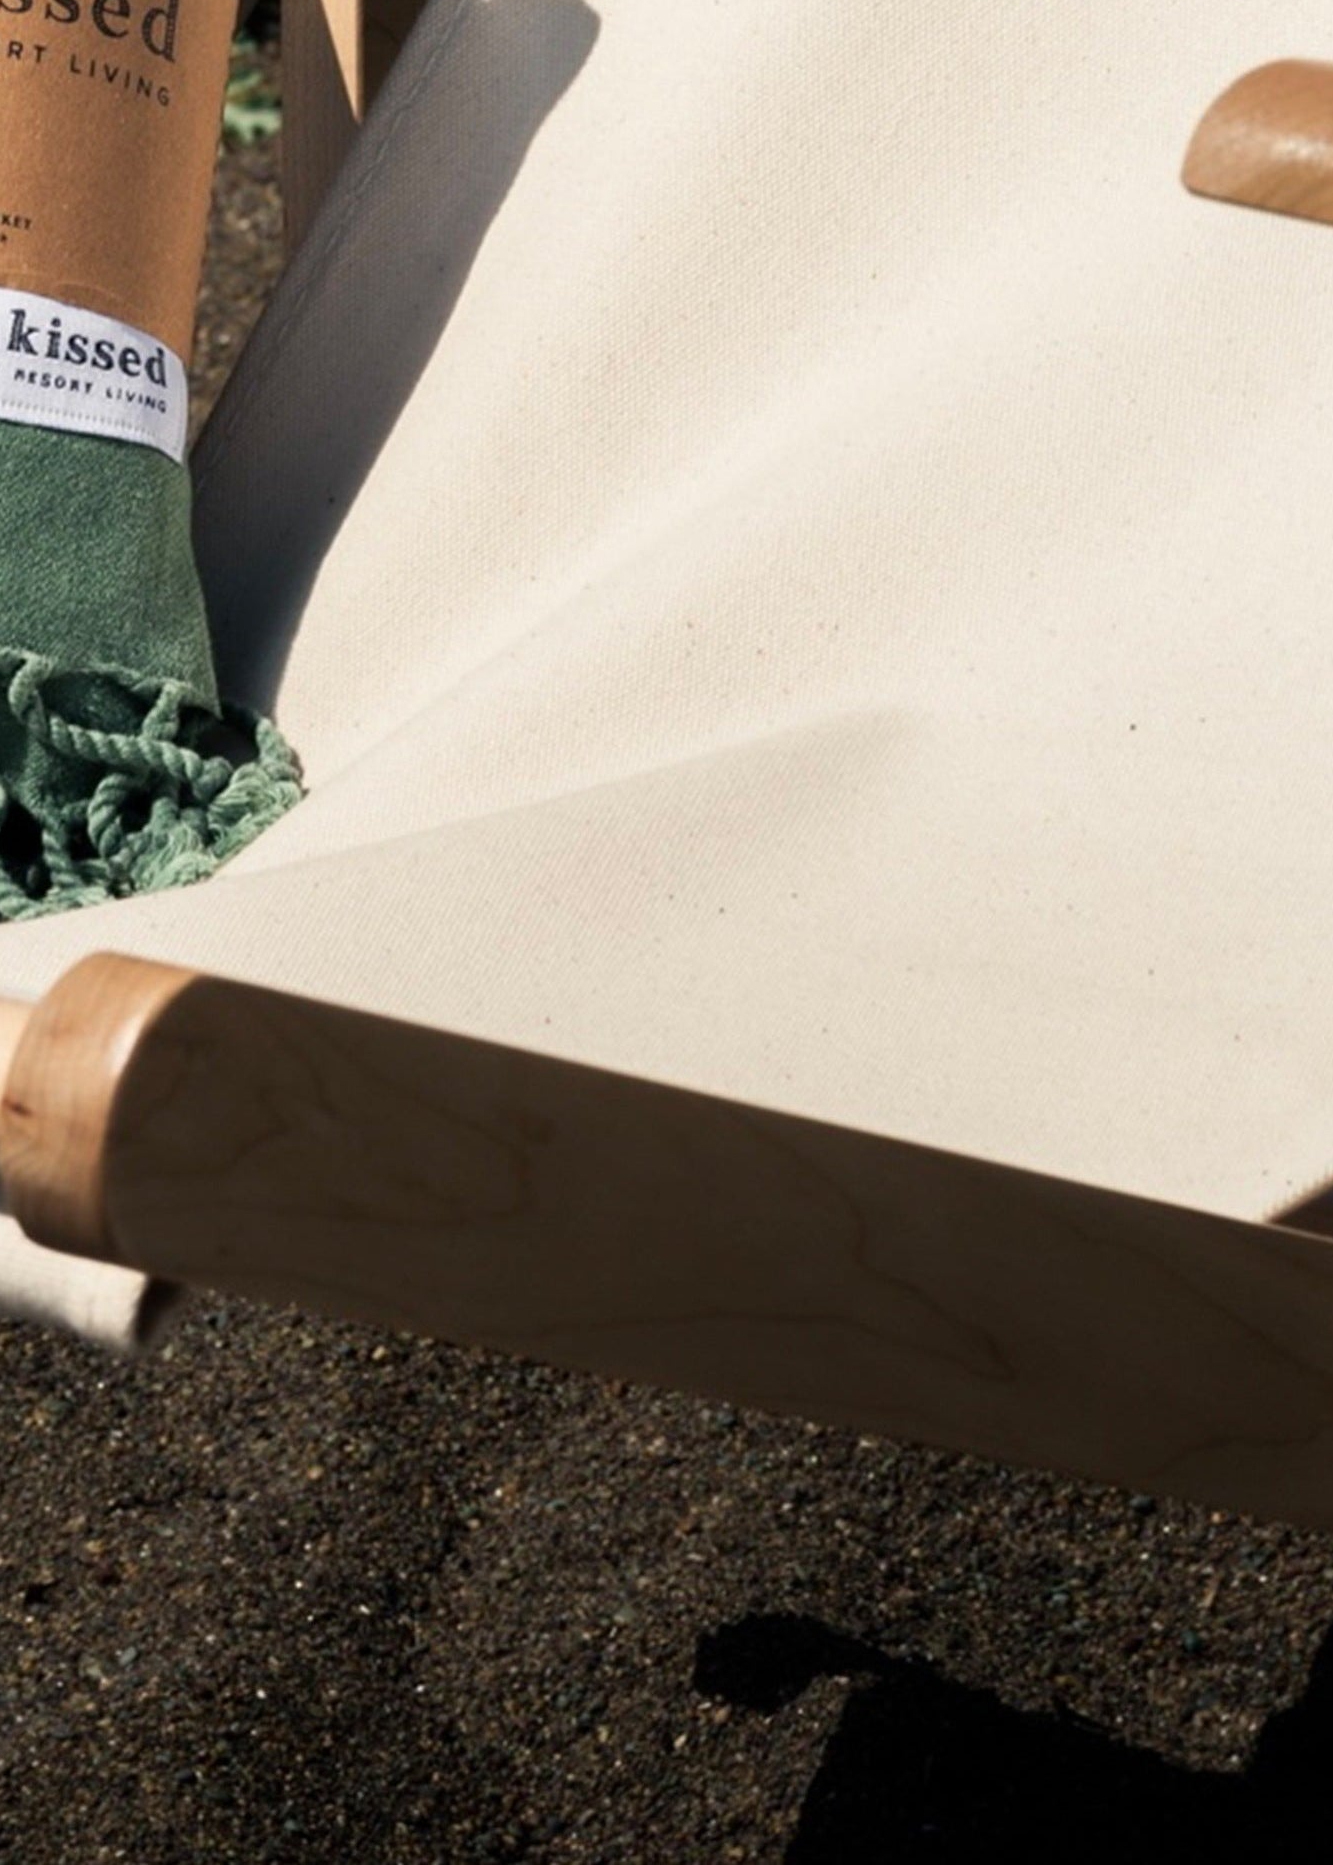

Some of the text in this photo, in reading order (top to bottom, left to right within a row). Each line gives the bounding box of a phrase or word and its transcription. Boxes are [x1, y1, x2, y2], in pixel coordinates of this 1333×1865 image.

[70, 54, 171, 107] LIVING
[14, 369, 94, 395] RESORT
[106, 388, 168, 414] LIVING
